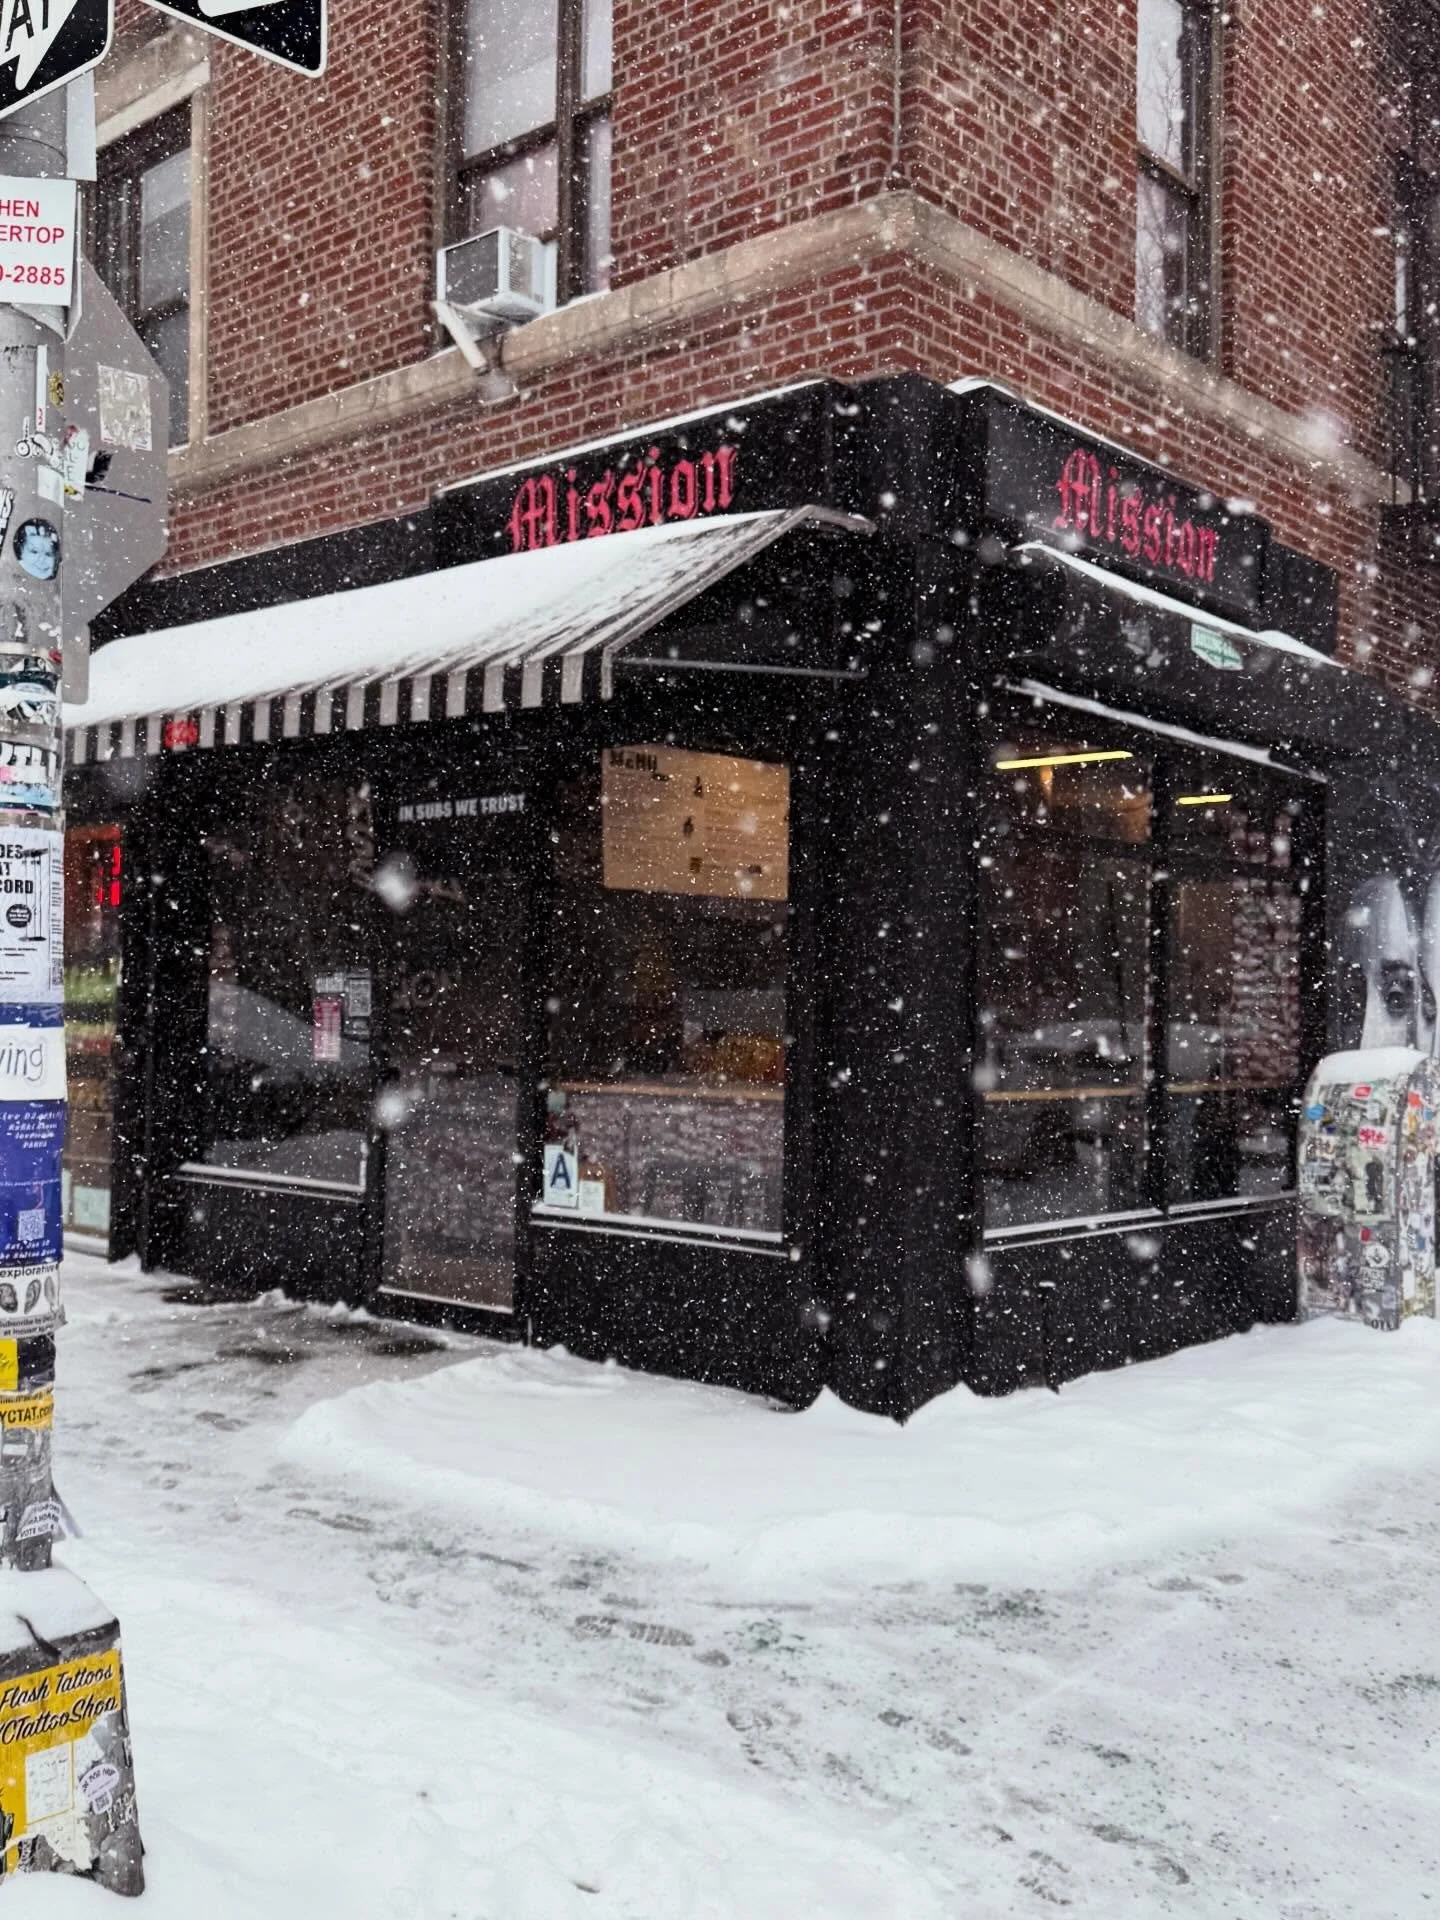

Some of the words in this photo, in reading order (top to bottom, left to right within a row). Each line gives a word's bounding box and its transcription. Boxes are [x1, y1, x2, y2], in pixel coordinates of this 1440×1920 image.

[505, 445, 737, 553] Mission
[1055, 447, 1217, 583] Mission
[399, 805, 414, 822] IN
[415, 802, 452, 820] SUBS
[455, 799, 477, 817] WE
[480, 793, 525, 815] TRUST
[550, 1153, 571, 1189] A
[0, 1677, 50, 1711] Flash
[55, 1665, 113, 1695] Tattoos
